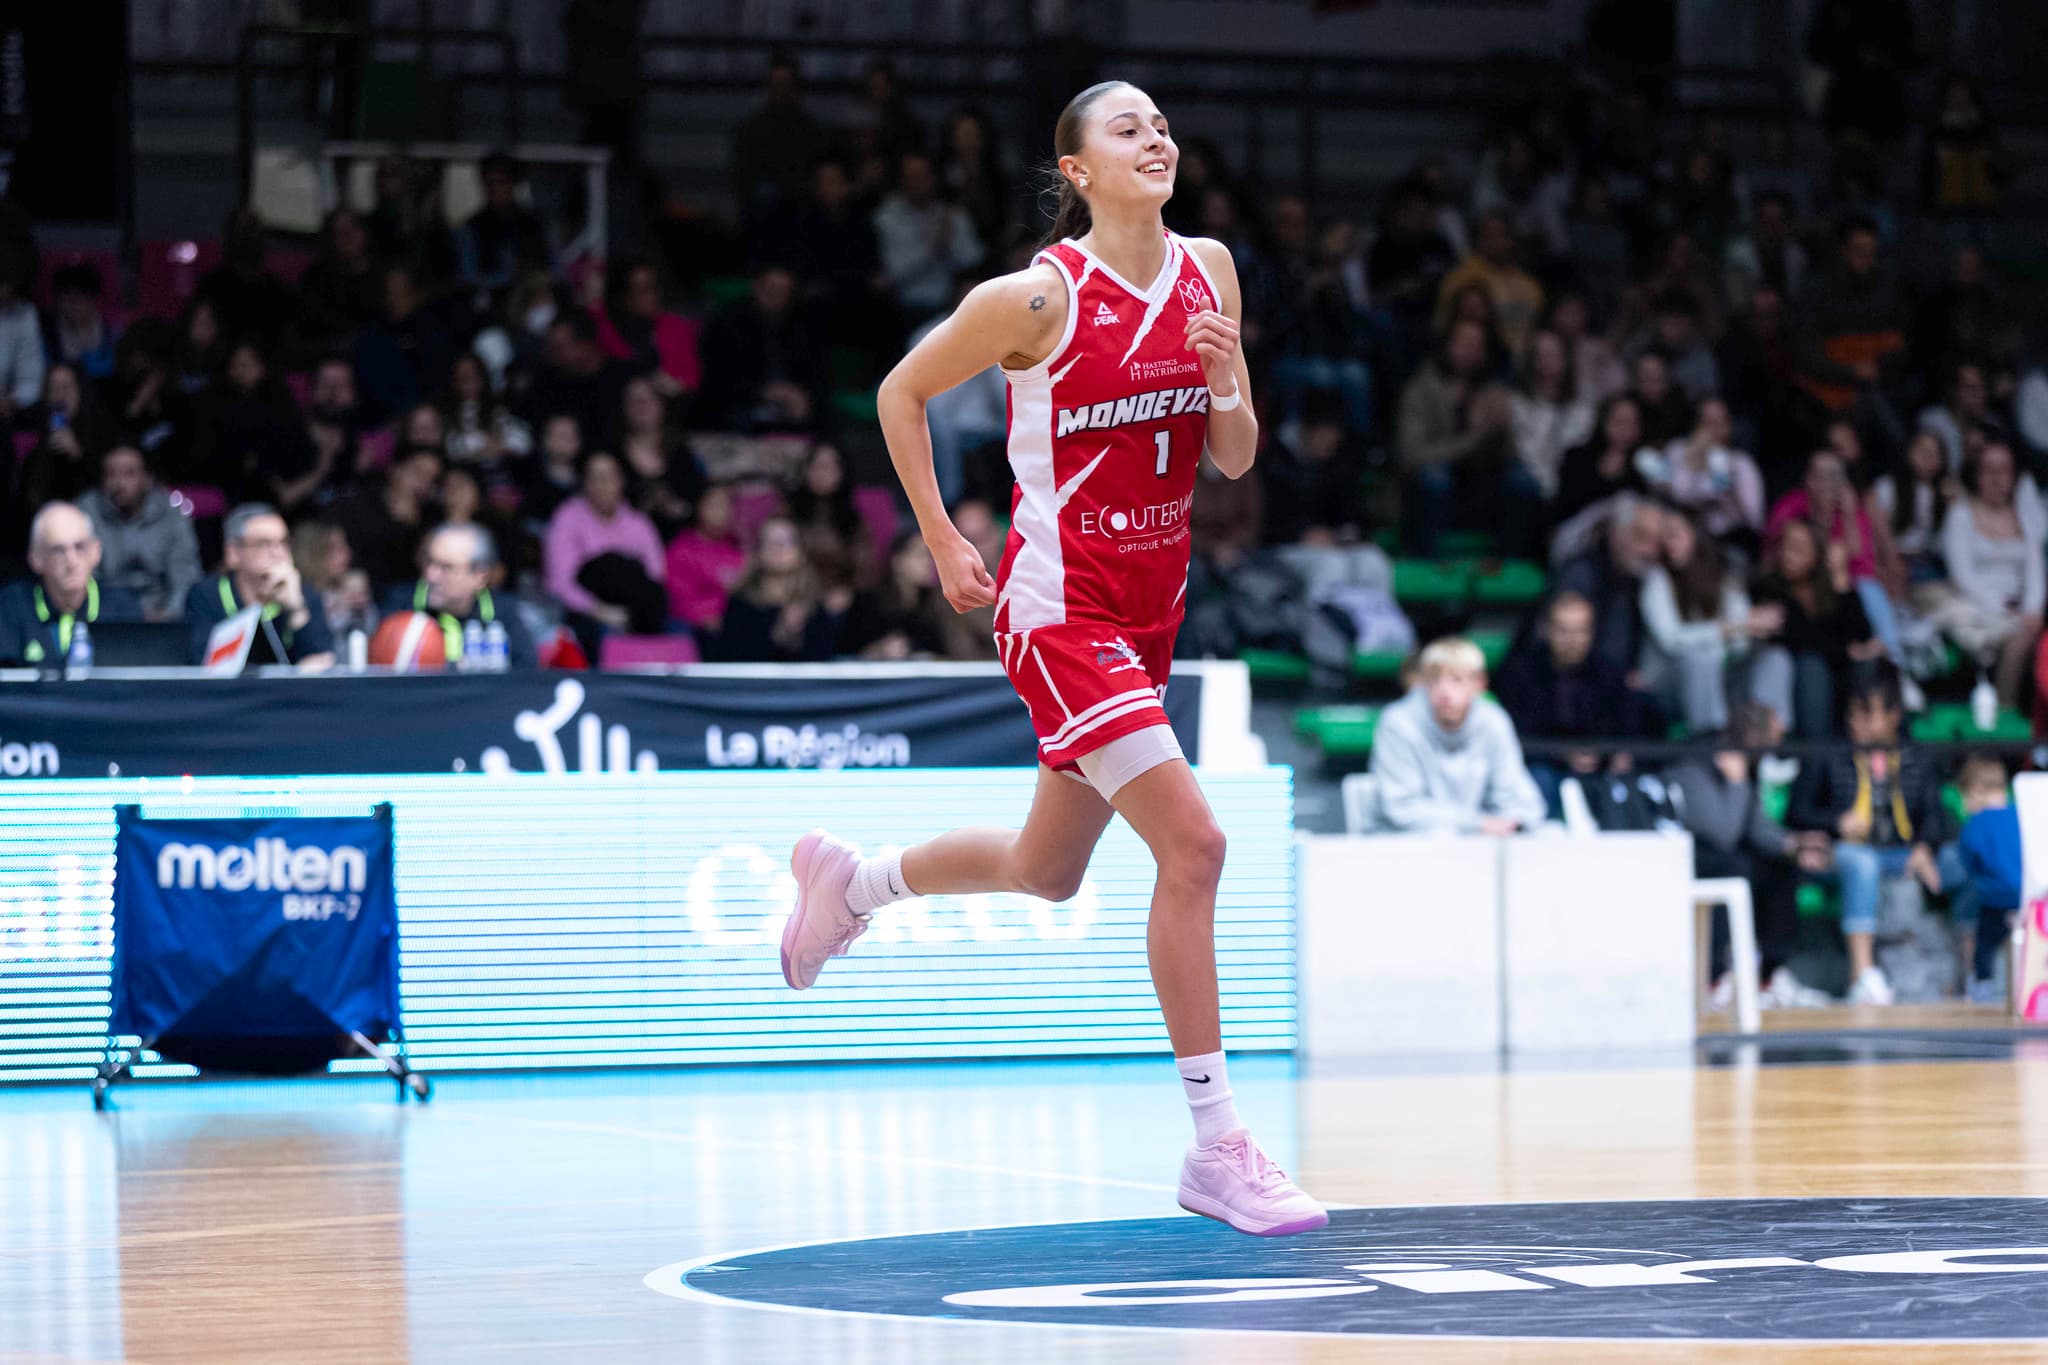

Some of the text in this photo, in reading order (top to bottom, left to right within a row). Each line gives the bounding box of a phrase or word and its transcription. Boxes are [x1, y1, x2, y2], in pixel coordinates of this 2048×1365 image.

[1094, 314, 1121, 327] PEAK
[1142, 359, 1178, 370] HASTINGS
[1143, 363, 1199, 379] PATRIMOINE
[1154, 430, 1171, 476] 1
[1118, 540, 1160, 554] OPTIQUE
[0, 741, 60, 777] on
[706, 723, 911, 771] La Région
[157, 837, 368, 893] molten
[282, 893, 362, 922] BKF-7
